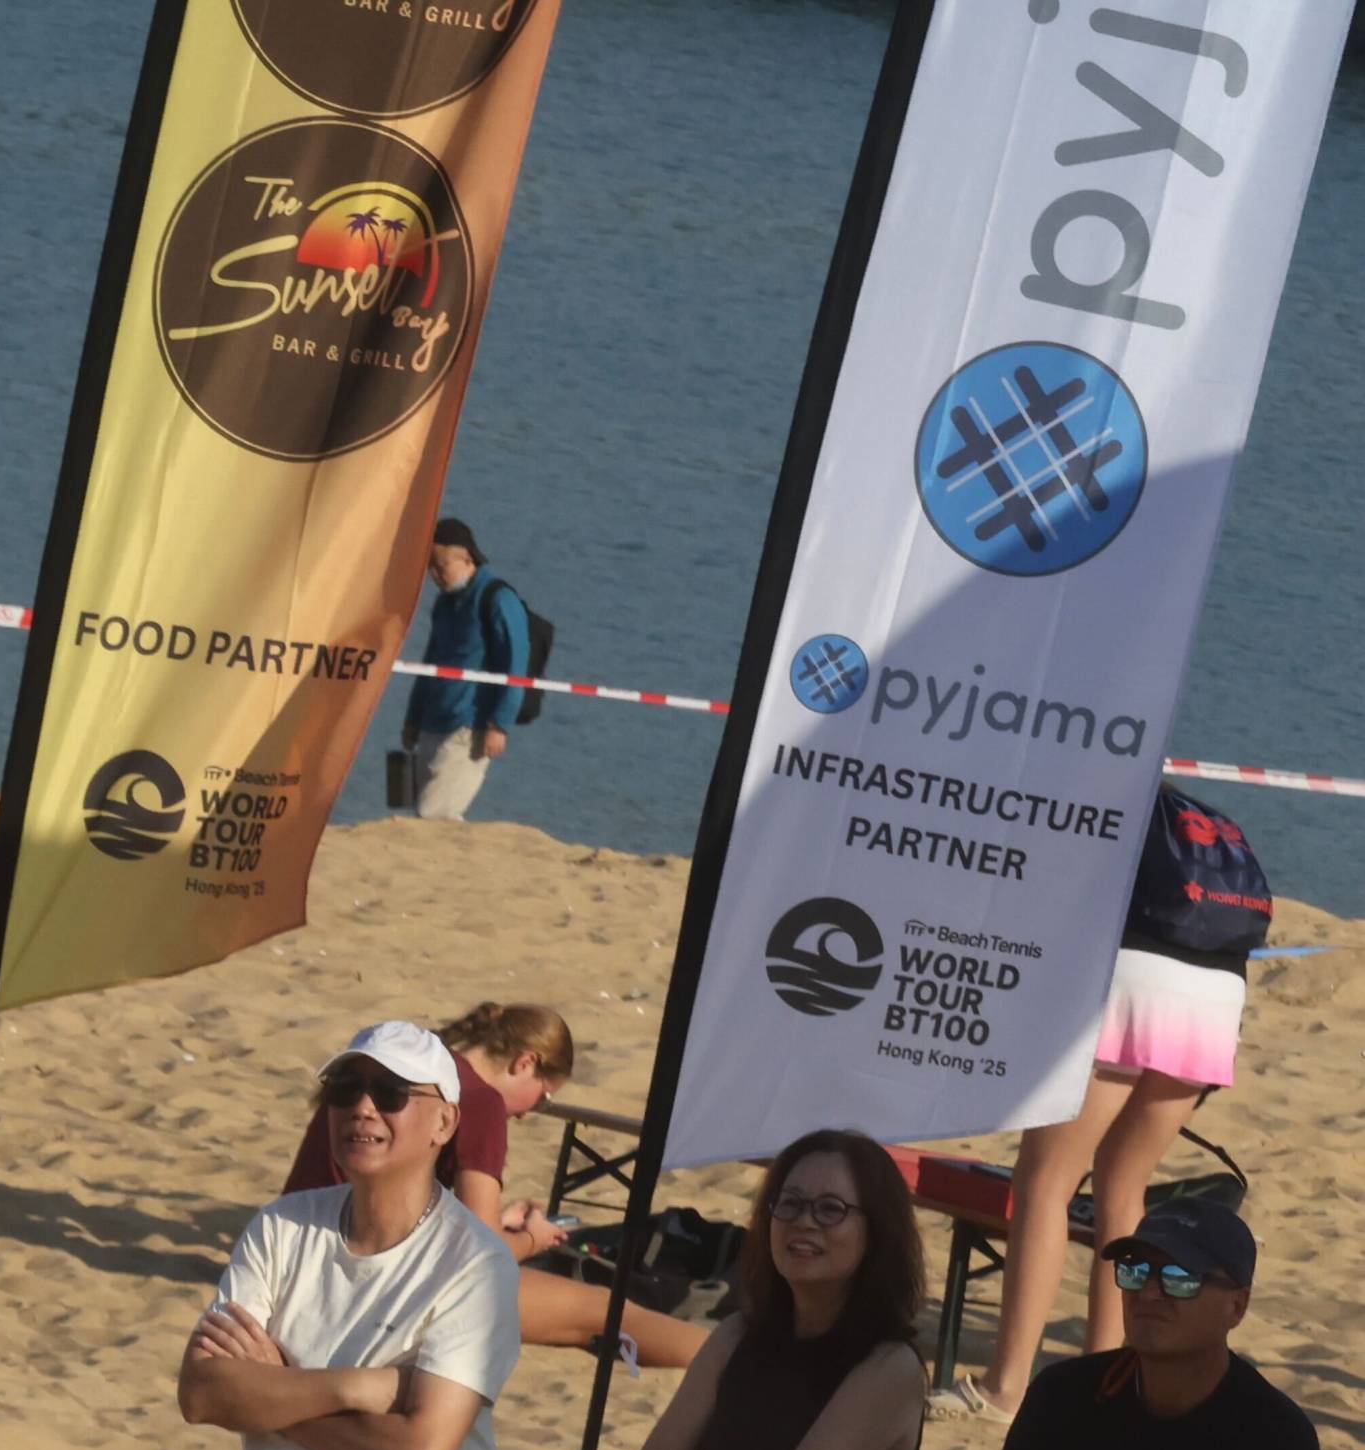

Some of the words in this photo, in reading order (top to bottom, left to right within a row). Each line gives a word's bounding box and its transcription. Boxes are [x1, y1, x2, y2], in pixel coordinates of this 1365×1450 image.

[424, 6, 486, 30] GRILL
[244, 176, 303, 221] The
[169, 229, 460, 341] Sunset
[272, 334, 318, 357] BAR
[325, 344, 340, 362] &
[349, 348, 406, 371] GRILL
[391, 305, 450, 373] Bay
[74, 611, 197, 660] FOOD
[205, 631, 377, 682] PARTNER
[871, 664, 1147, 758] pyjama
[200, 788, 288, 820] WORLD
[773, 744, 1124, 841] INFRASTRUCTURE
[196, 816, 266, 846] TOUR
[845, 816, 1028, 881] PARTNER
[189, 842, 263, 872] BT100
[937, 925, 989, 950] Beach
[990, 935, 1044, 960] Tennis
[899, 944, 1021, 991] WORLD
[893, 974, 984, 1016] TOUR
[883, 1003, 991, 1047] BT100
[877, 1039, 924, 1067] Hong
[927, 1048, 975, 1076] Kong
[980, 1057, 1008, 1078] '25
